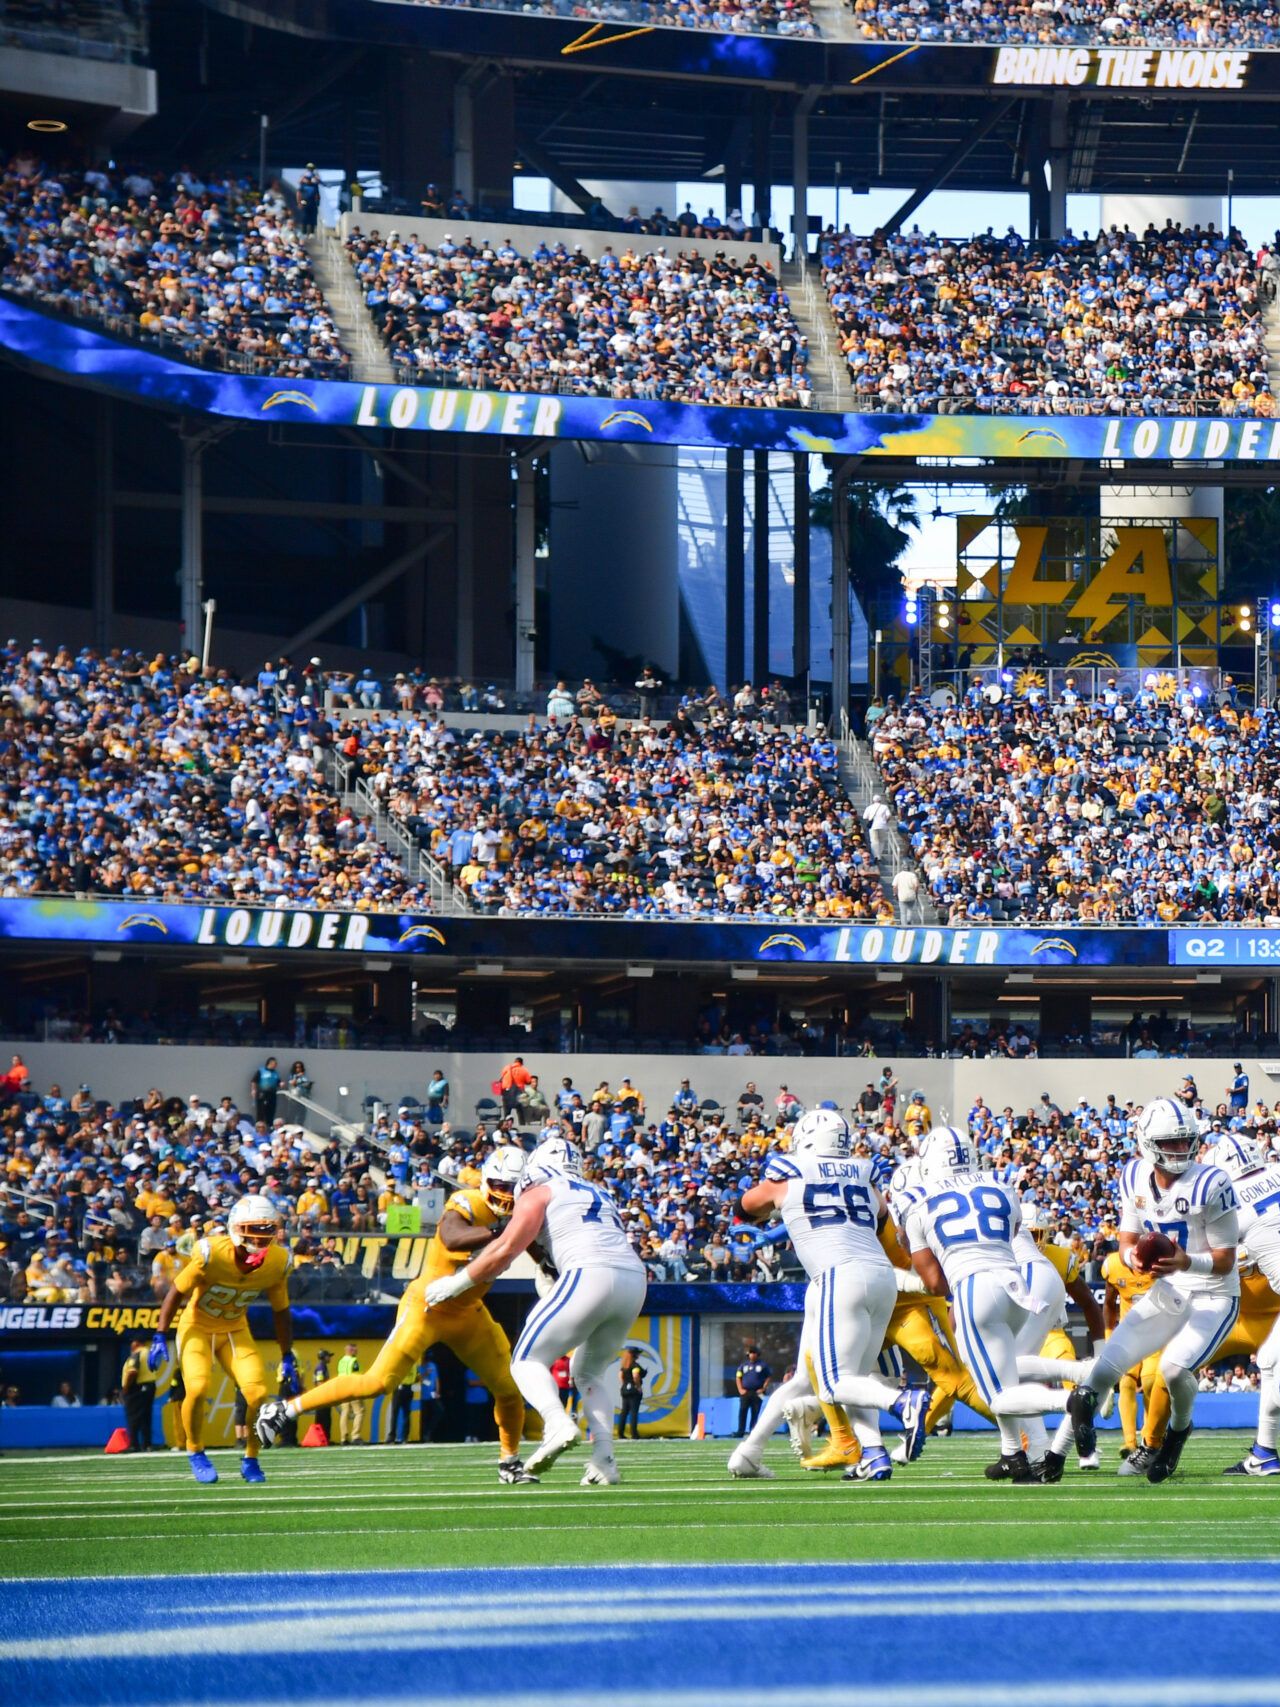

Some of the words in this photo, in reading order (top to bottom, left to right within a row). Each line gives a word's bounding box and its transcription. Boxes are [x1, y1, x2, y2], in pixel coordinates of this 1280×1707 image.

[994, 48, 1091, 86] BRING
[1096, 50, 1154, 87] THE
[1154, 51, 1250, 89] NOISE
[356, 386, 562, 437] LOUDER
[1003, 525, 1174, 643] LA
[197, 908, 370, 950] LOUDER
[835, 928, 999, 964] LOUDER
[1185, 938, 1226, 957] Q2
[817, 1162, 860, 1180] NELSON
[935, 1172, 987, 1191] TAYLOR
[802, 1183, 876, 1230] 56
[926, 1185, 1012, 1249] 28
[1219, 1186, 1240, 1212] 17
